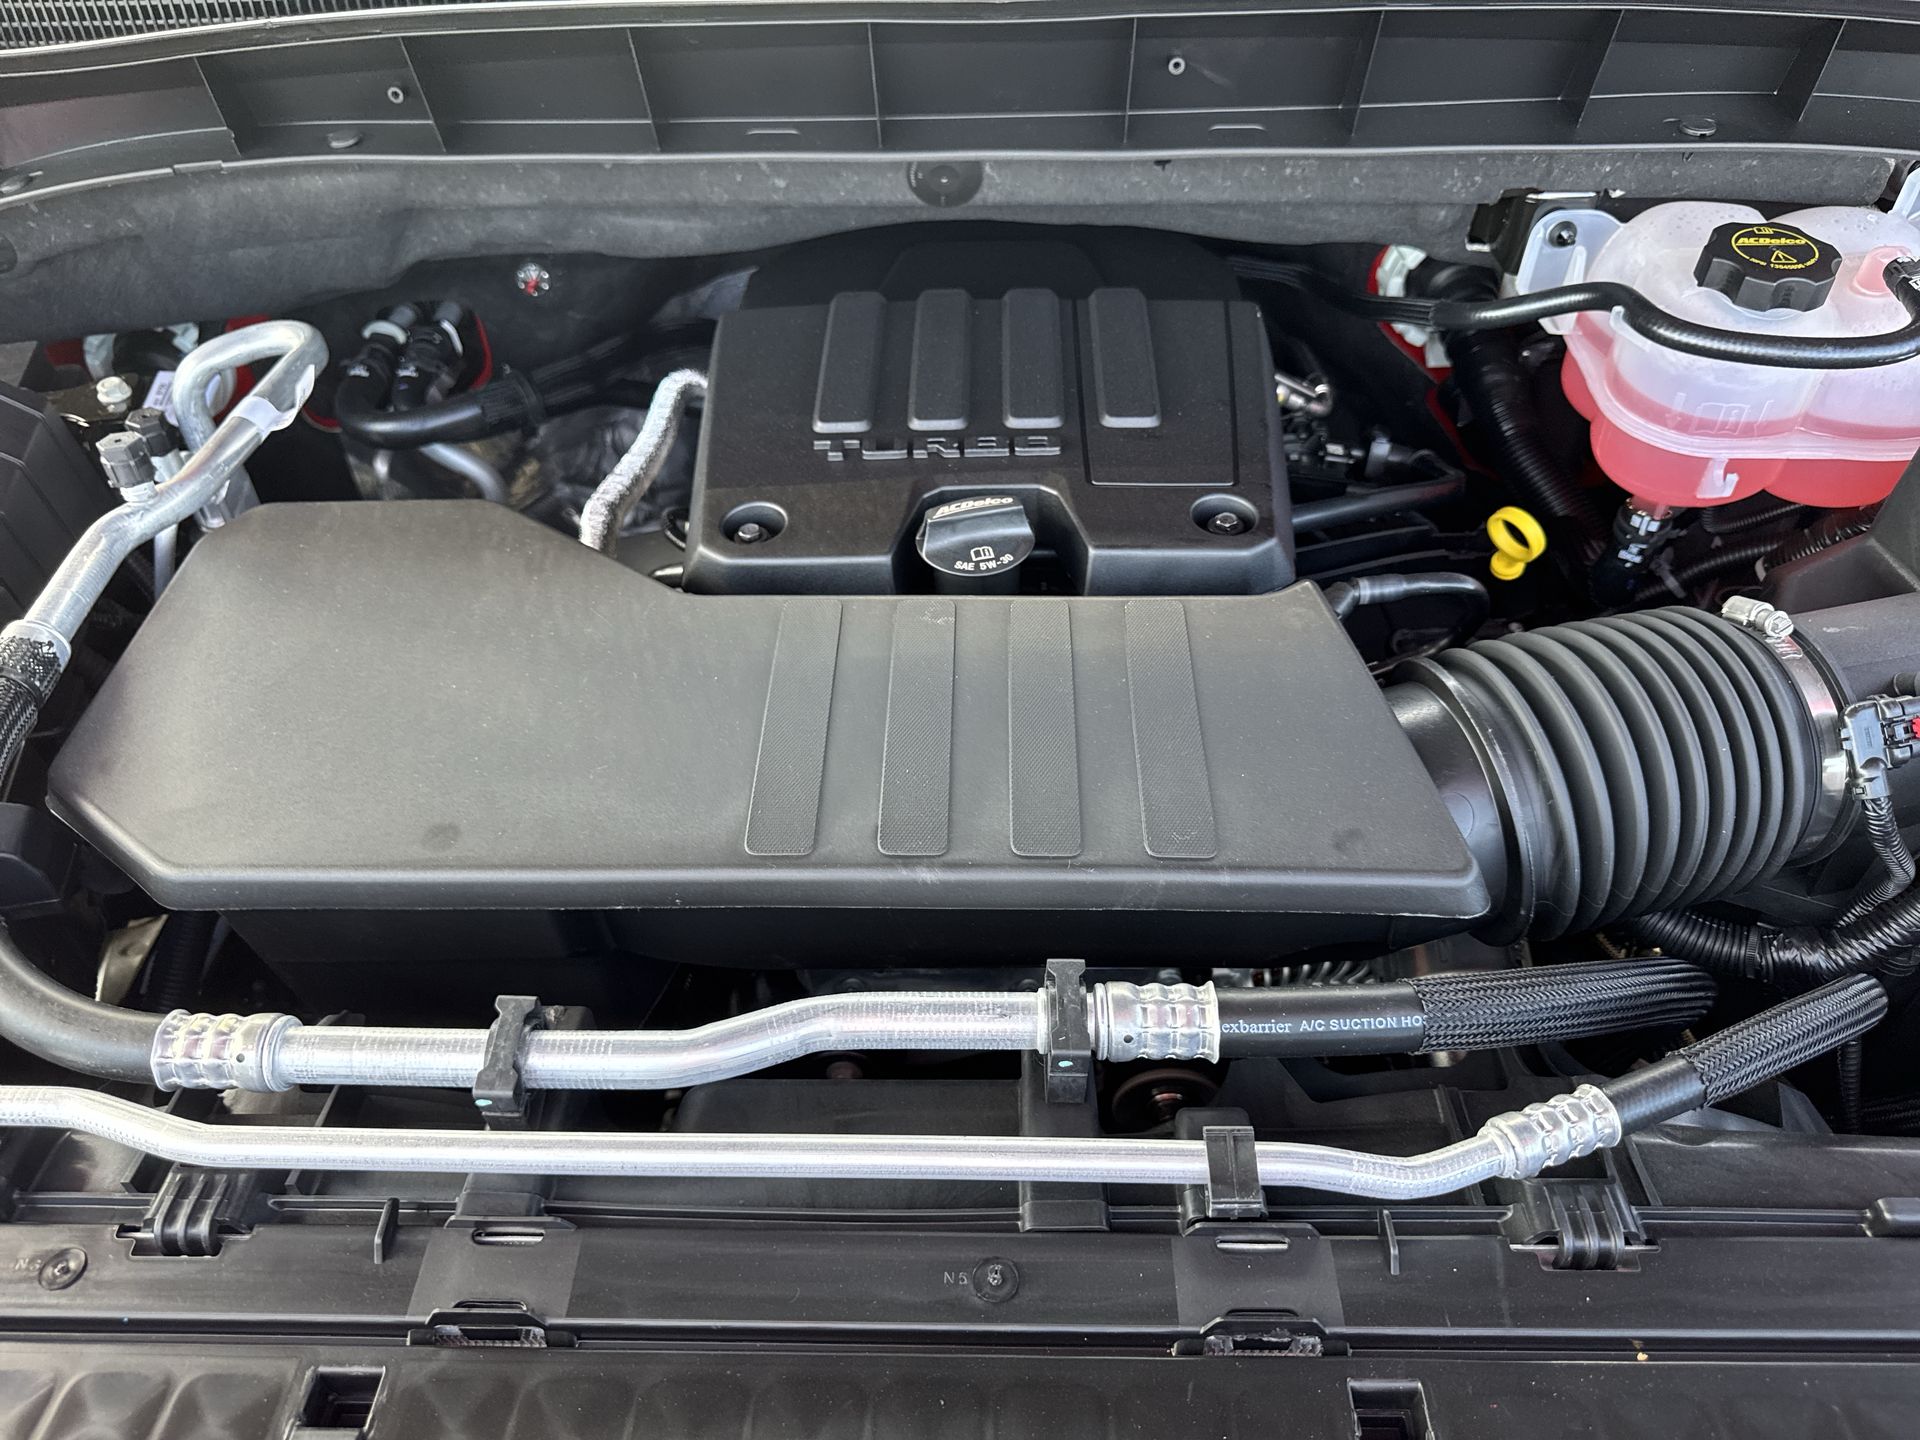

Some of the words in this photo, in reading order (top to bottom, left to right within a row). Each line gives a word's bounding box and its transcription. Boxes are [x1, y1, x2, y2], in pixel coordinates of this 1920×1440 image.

[1735, 237, 1806, 246] ACDelco
[933, 497, 1014, 519] ACDelco
[954, 560, 975, 571] SAE
[979, 553, 1014, 570] 5W-30
[1220, 1019, 1292, 1034] exbarrier
[1299, 1019, 1326, 1032] A/C
[1329, 1017, 1397, 1031] SUCTION
[1401, 1015, 1425, 1028] HO
